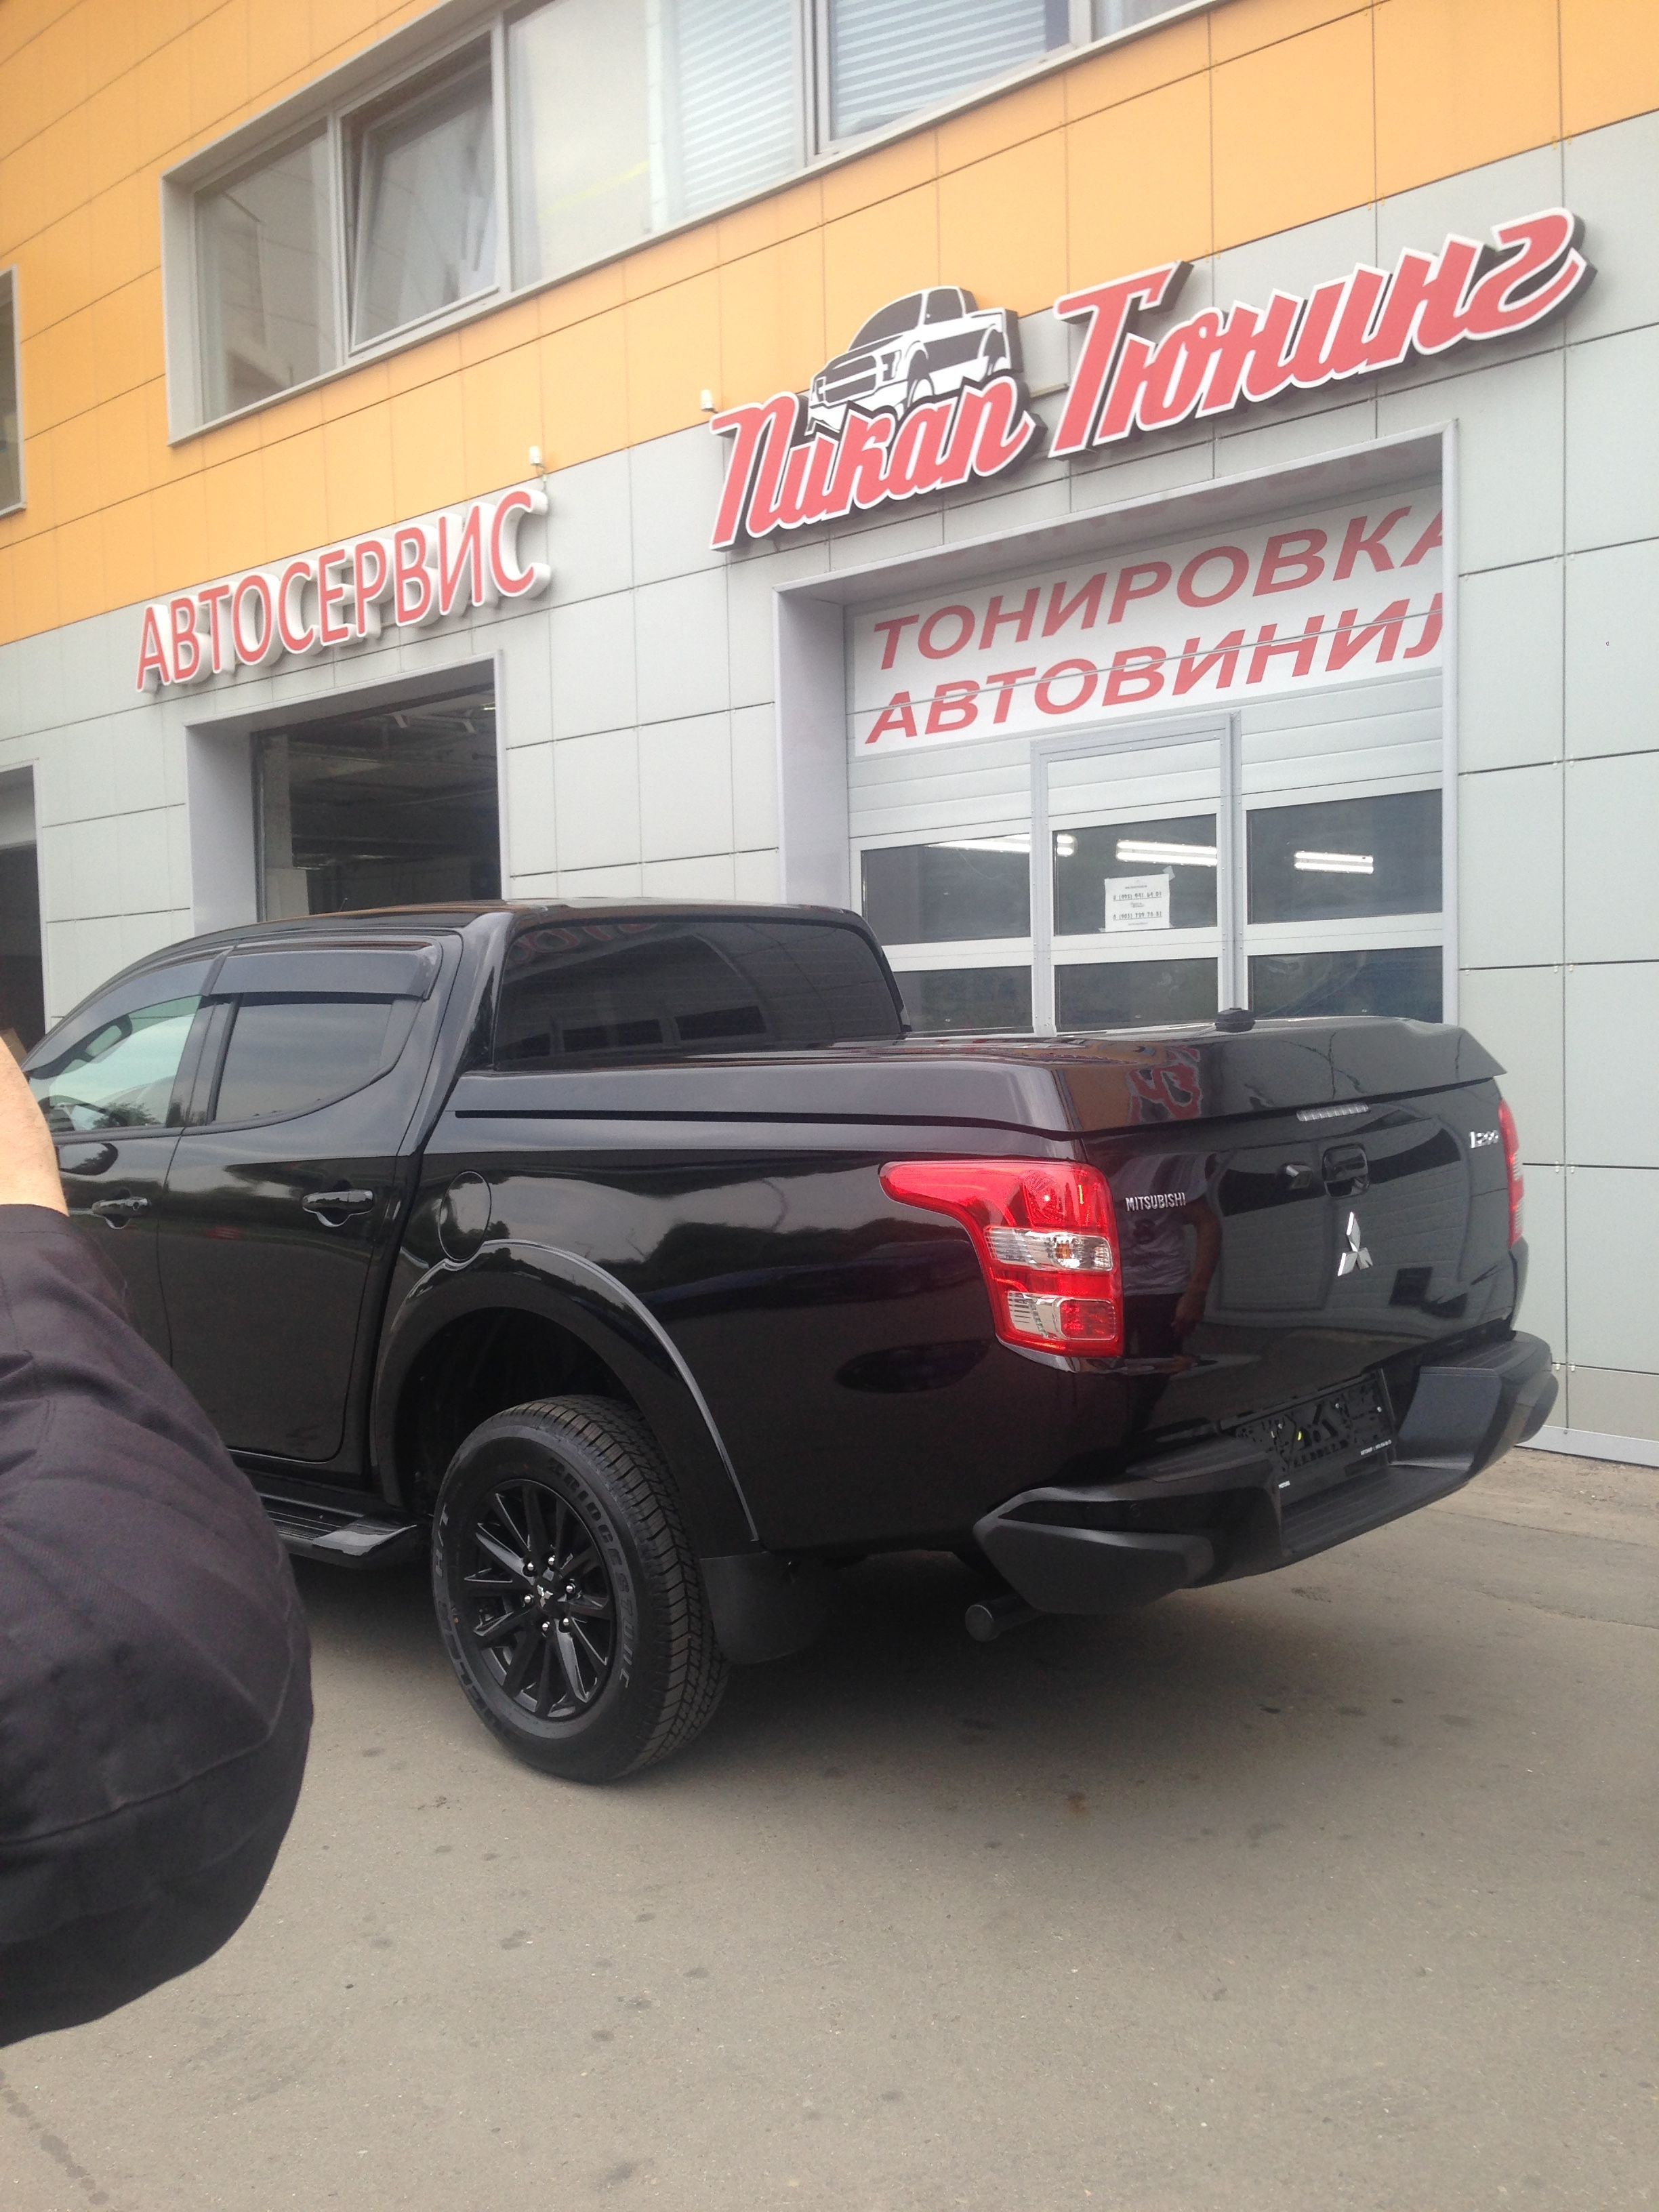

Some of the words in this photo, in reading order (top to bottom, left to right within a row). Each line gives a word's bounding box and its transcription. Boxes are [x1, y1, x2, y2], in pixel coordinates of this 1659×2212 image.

[710, 374, 1037, 550] Пикап
[1048, 207, 1588, 458] Тюнинг
[136, 488, 546, 693] АВТОСЕРВИС
[1125, 1191, 1187, 1212] MITSUBISHI
